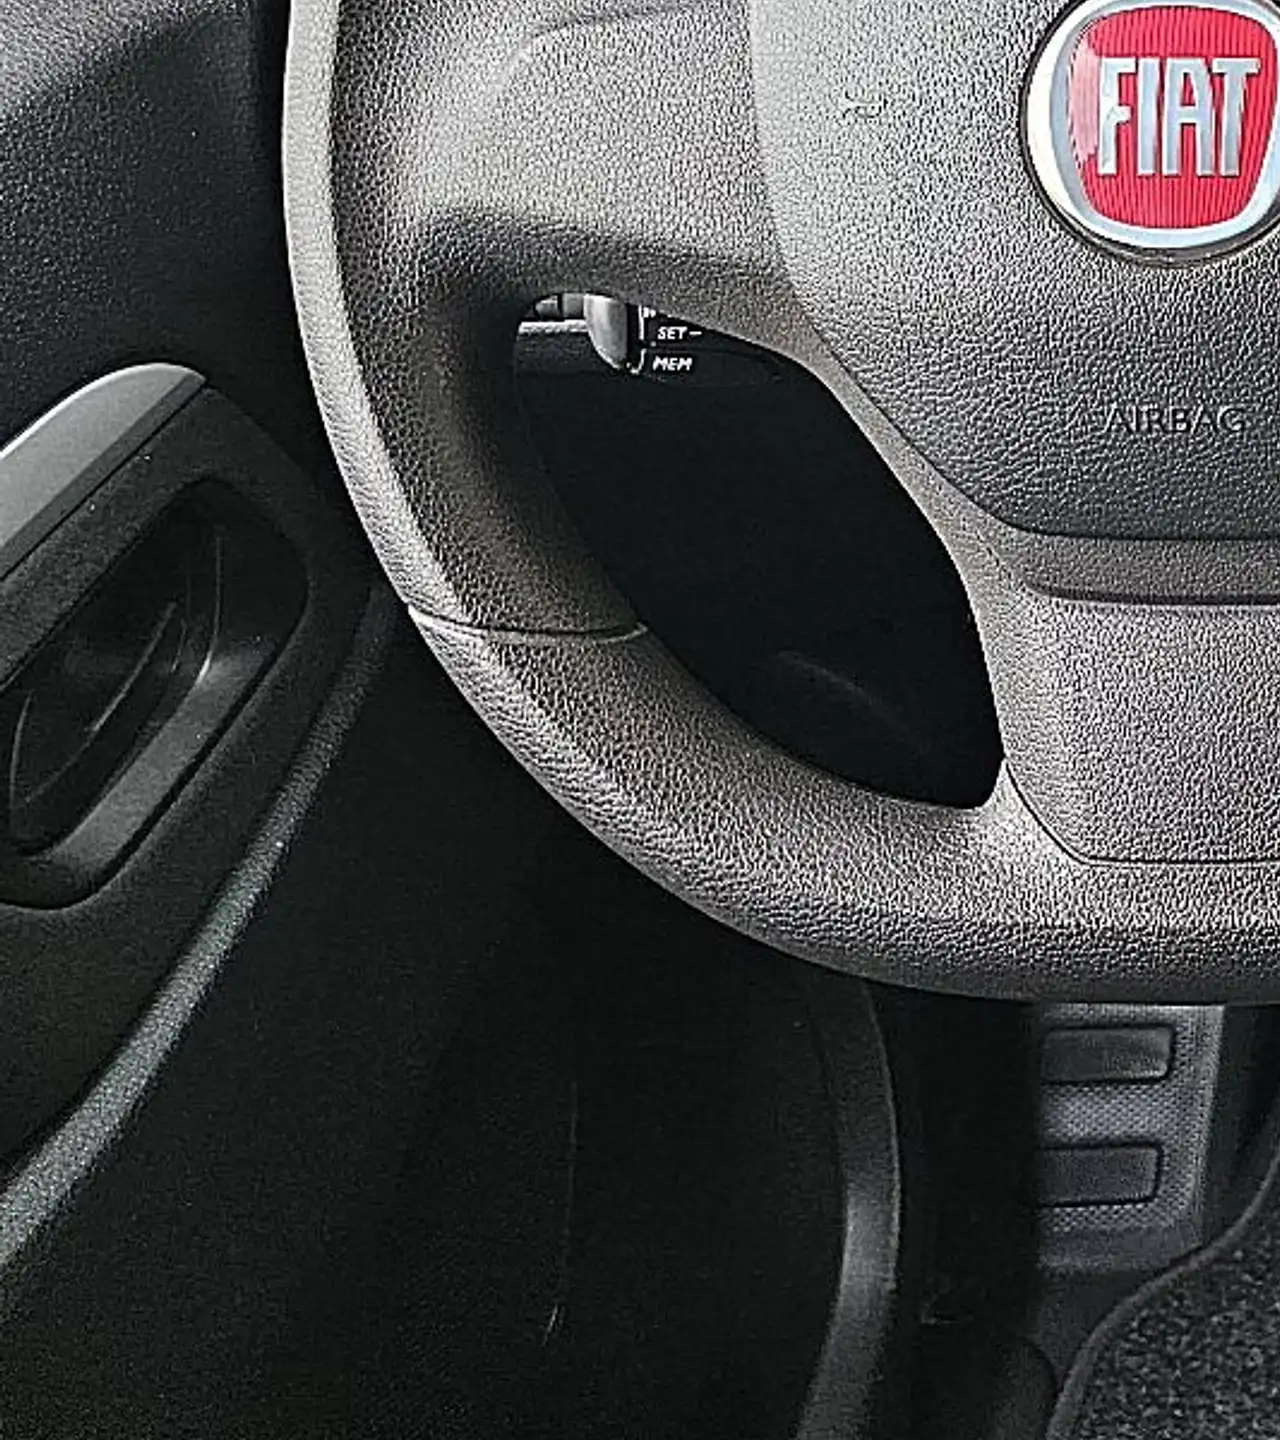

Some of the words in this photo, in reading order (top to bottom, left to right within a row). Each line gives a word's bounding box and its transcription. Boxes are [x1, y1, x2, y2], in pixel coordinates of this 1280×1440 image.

[1096, 56, 1260, 177] FIAT
[651, 354, 693, 372] MEM
[1104, 406, 1248, 434] AIRBAG
